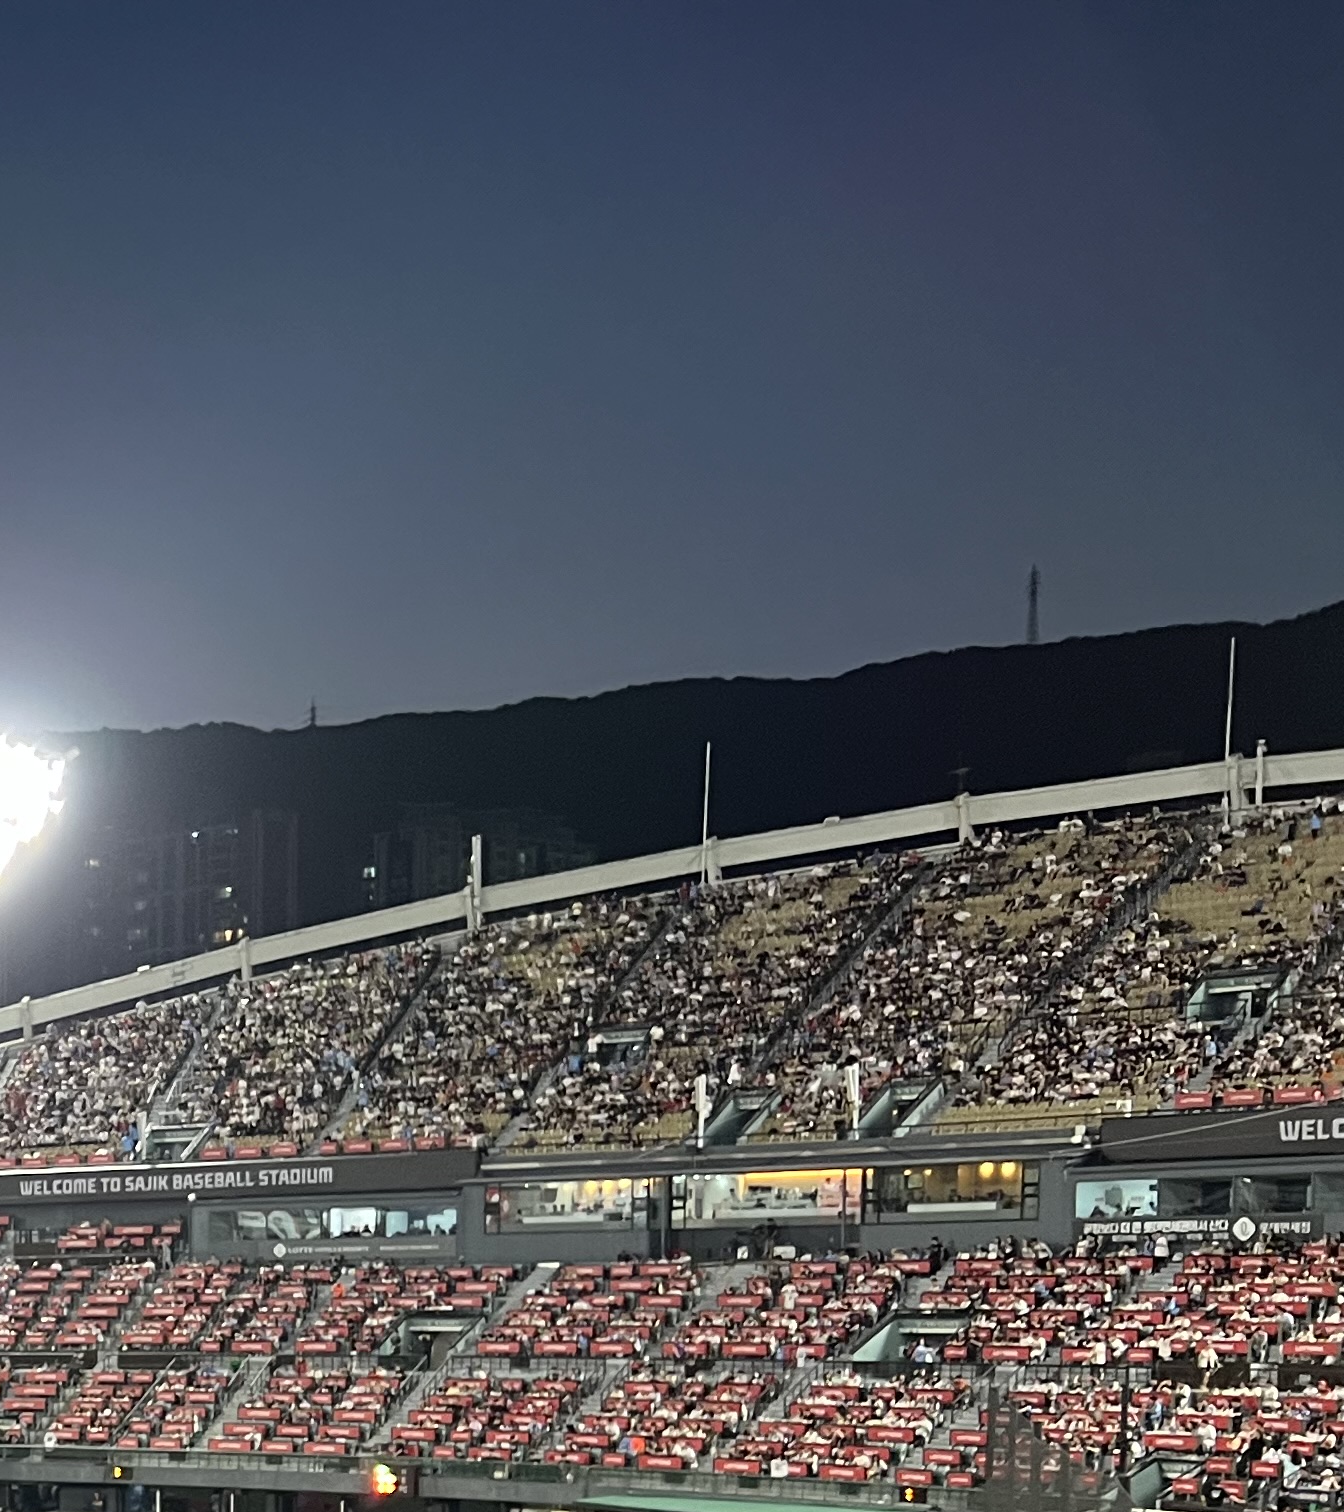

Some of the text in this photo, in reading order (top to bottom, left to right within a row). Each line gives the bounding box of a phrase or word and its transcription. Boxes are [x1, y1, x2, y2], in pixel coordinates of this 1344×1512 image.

[19, 1167, 333, 1195] WELCOME TO SAJIK BASEBALL STADIUM
